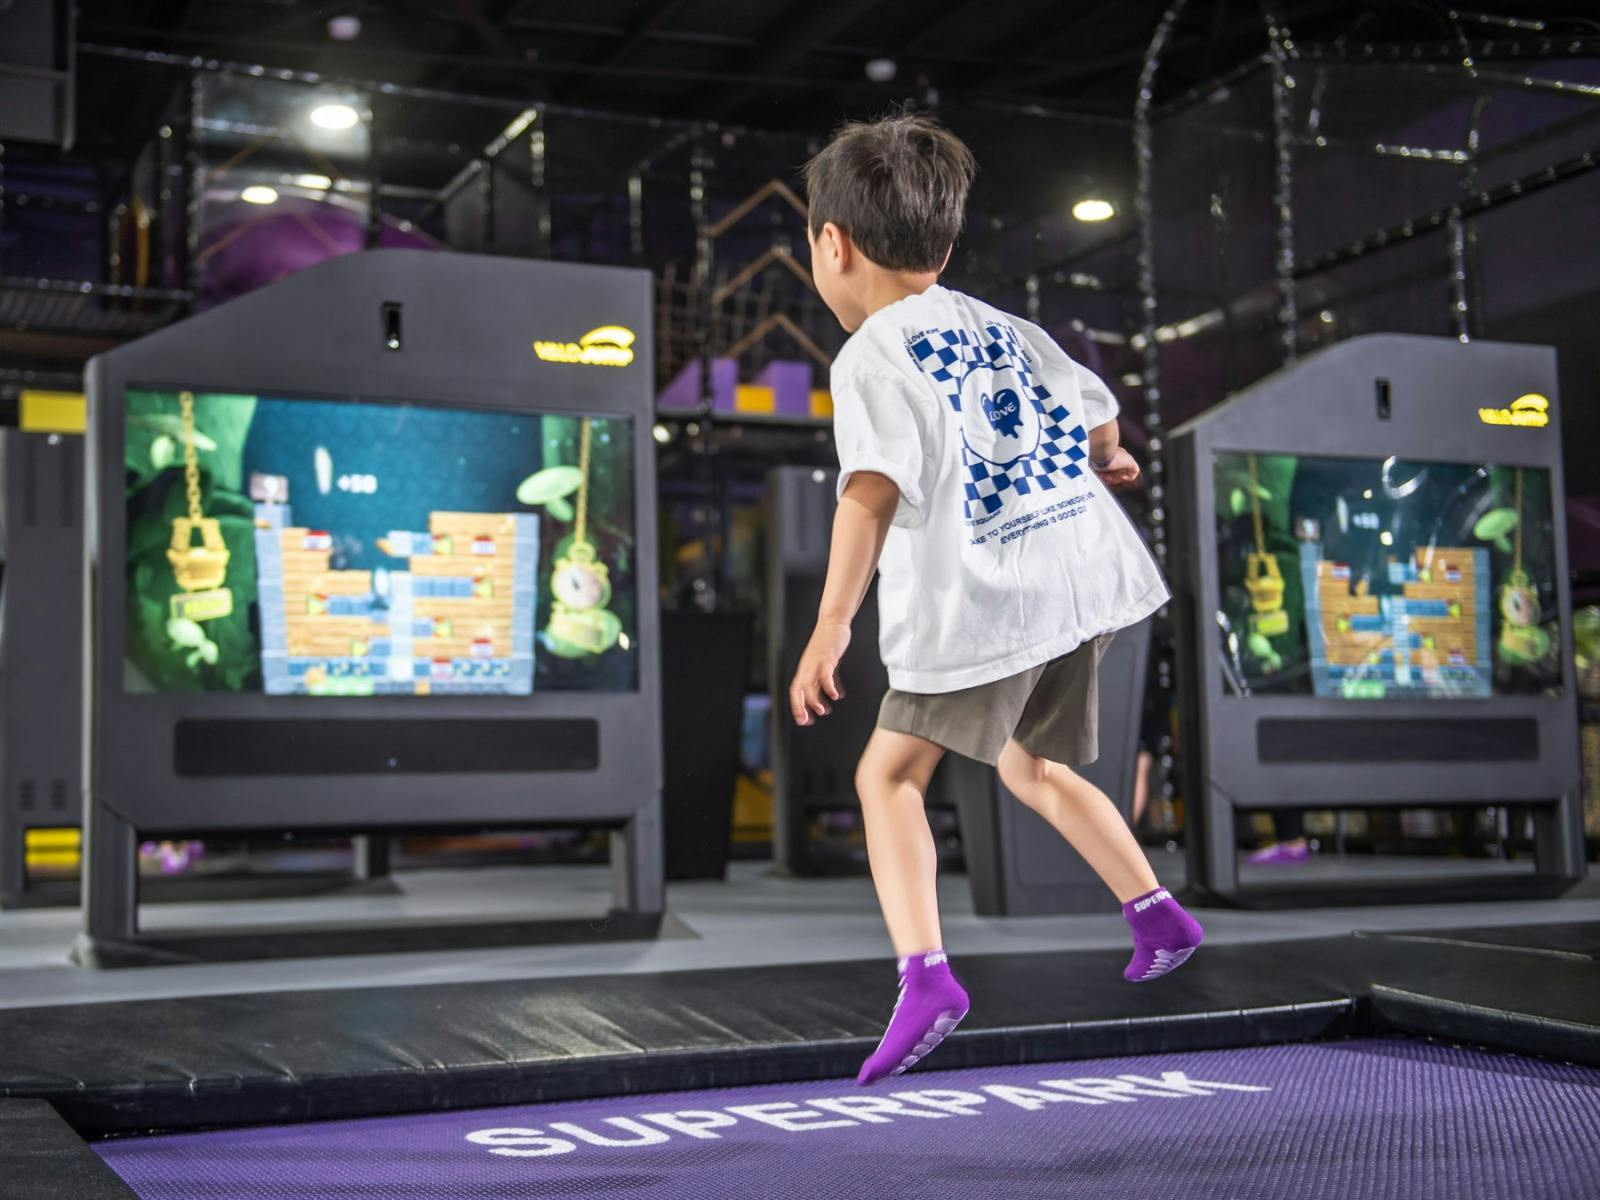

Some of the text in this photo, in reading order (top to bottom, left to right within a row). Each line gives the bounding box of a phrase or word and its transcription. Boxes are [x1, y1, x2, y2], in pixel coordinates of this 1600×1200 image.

[990, 402, 1016, 421] LOVE
[969, 535, 987, 545] AKE
[987, 529, 999, 538] TO
[999, 511, 1039, 531] YOURSELF
[1000, 519, 1048, 544] EVERYTHING
[466, 1071, 1272, 1158] SUPERPARK
